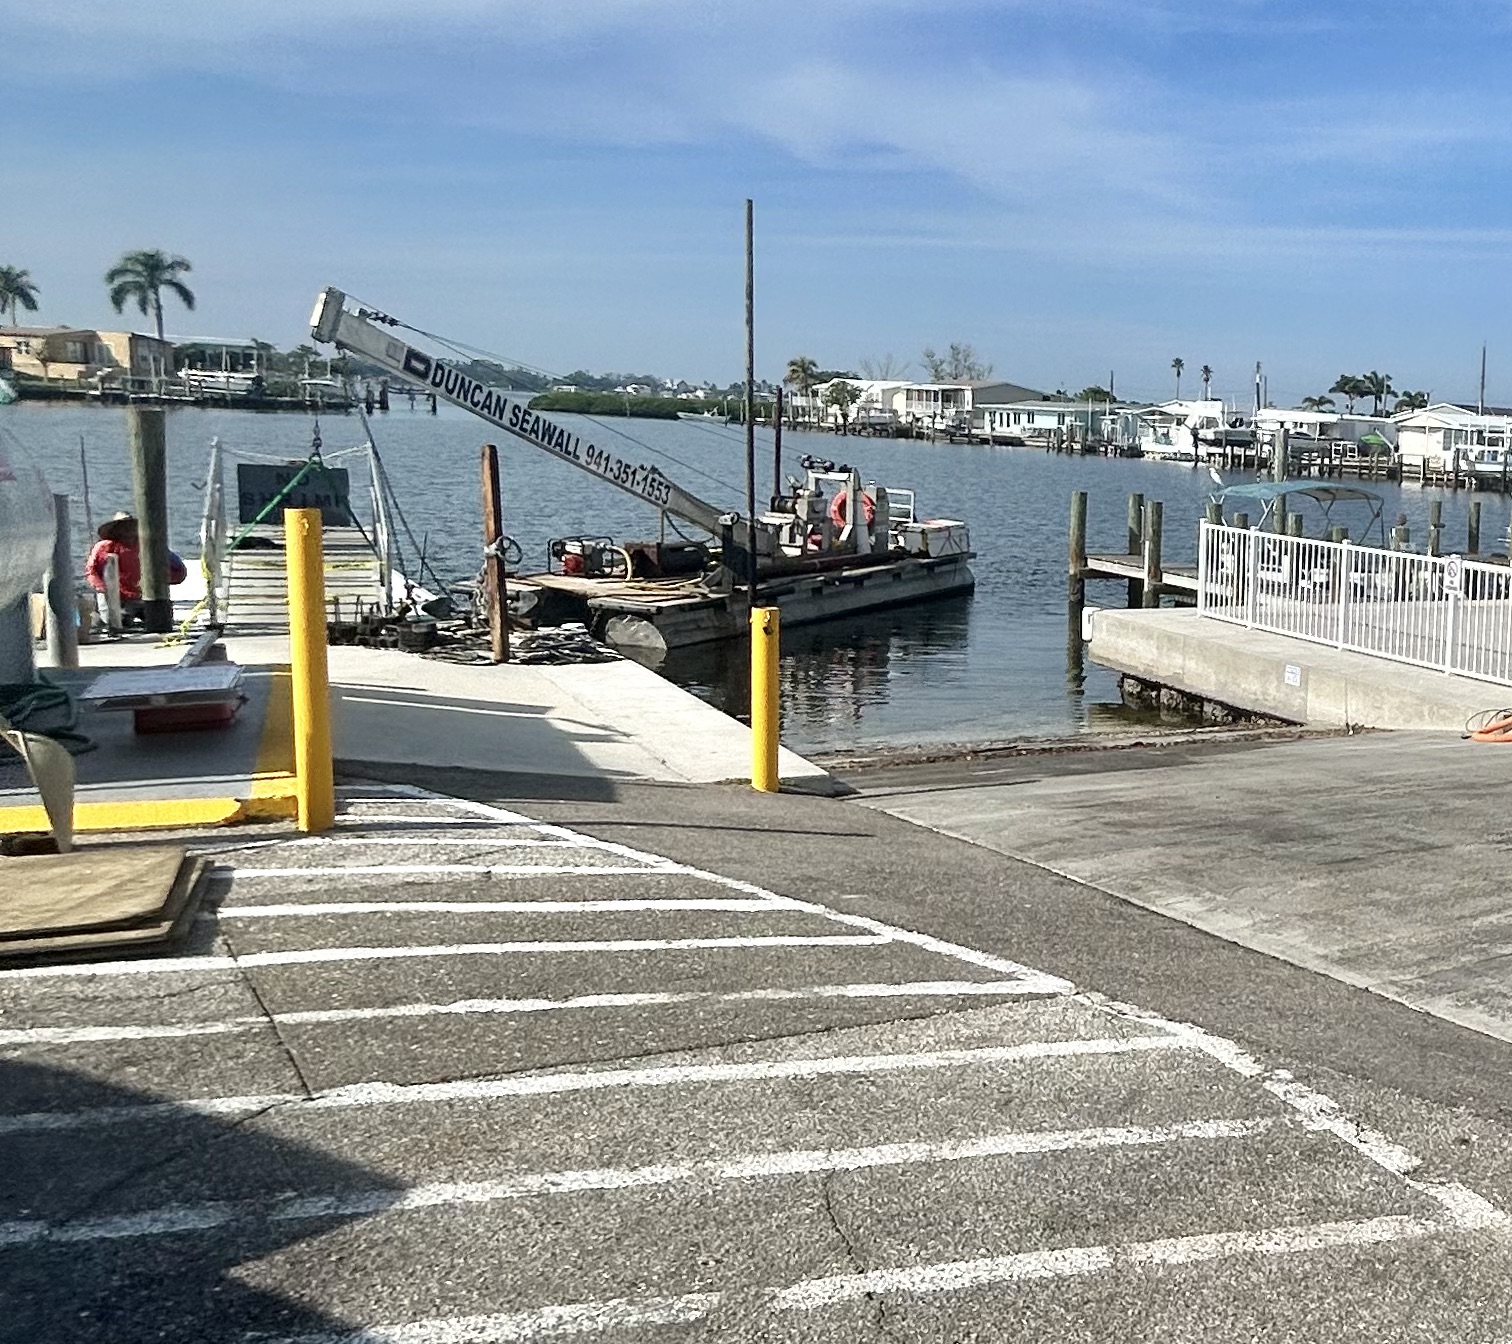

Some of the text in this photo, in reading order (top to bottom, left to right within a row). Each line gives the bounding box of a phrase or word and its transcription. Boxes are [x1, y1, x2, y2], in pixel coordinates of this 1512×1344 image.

[431, 360, 508, 421] DUNCAN
[509, 404, 580, 460] SEAWALL
[585, 444, 671, 506] 941-351-1553
